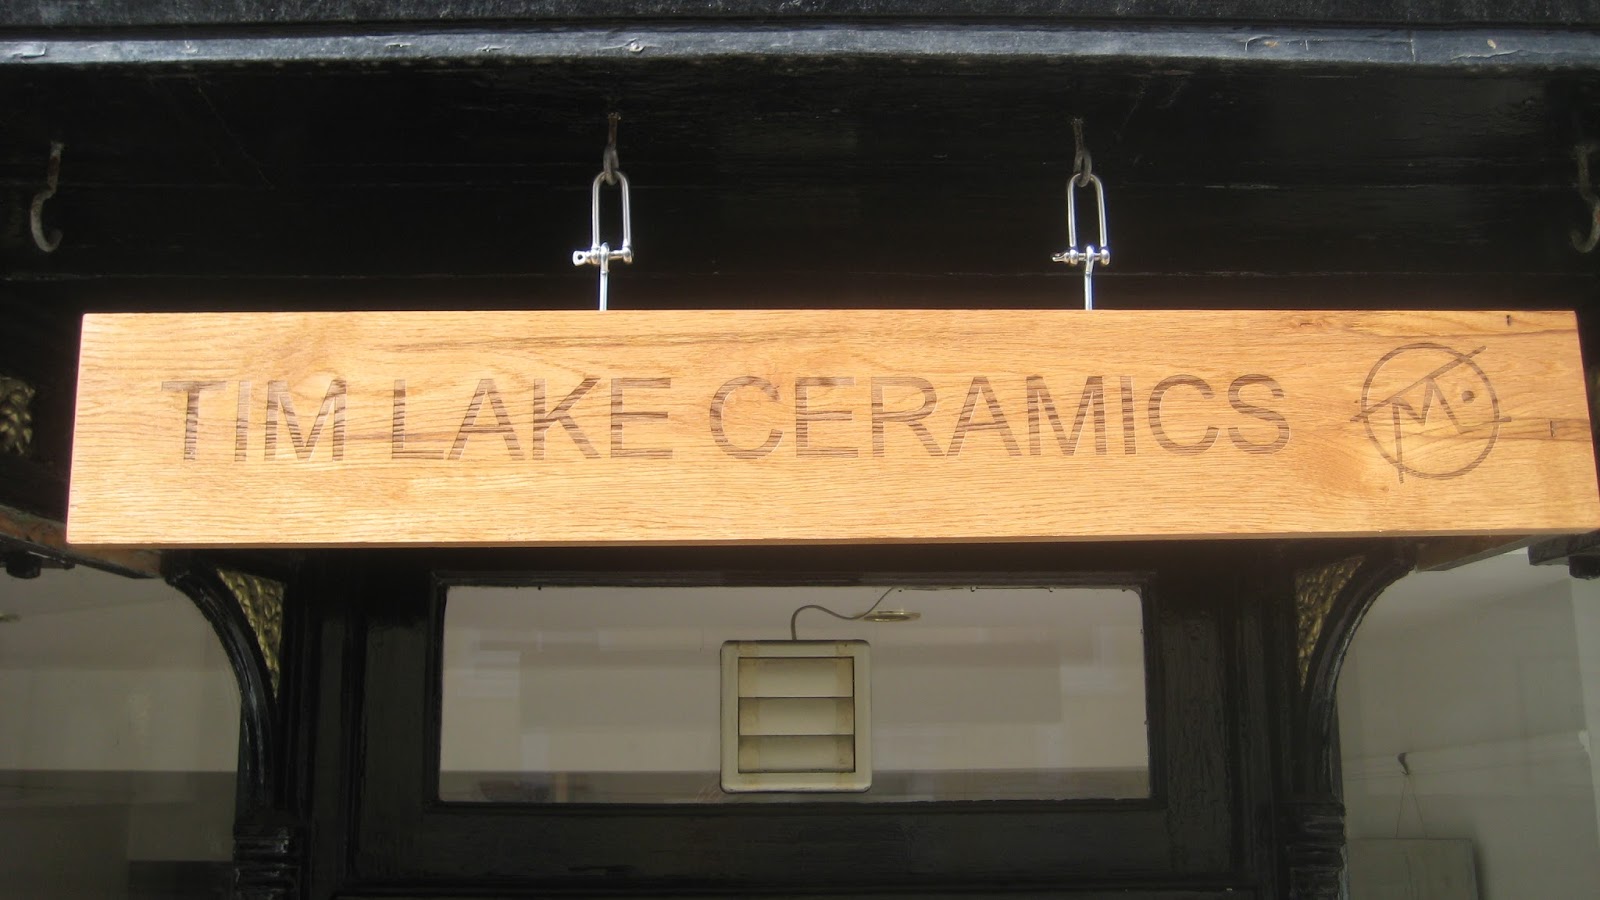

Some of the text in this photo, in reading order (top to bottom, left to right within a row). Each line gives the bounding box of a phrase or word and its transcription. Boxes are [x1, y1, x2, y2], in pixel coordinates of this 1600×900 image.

[161, 378, 347, 462] TIM
[391, 377, 674, 460] LAKE
[708, 373, 1292, 459] CERAMICS
